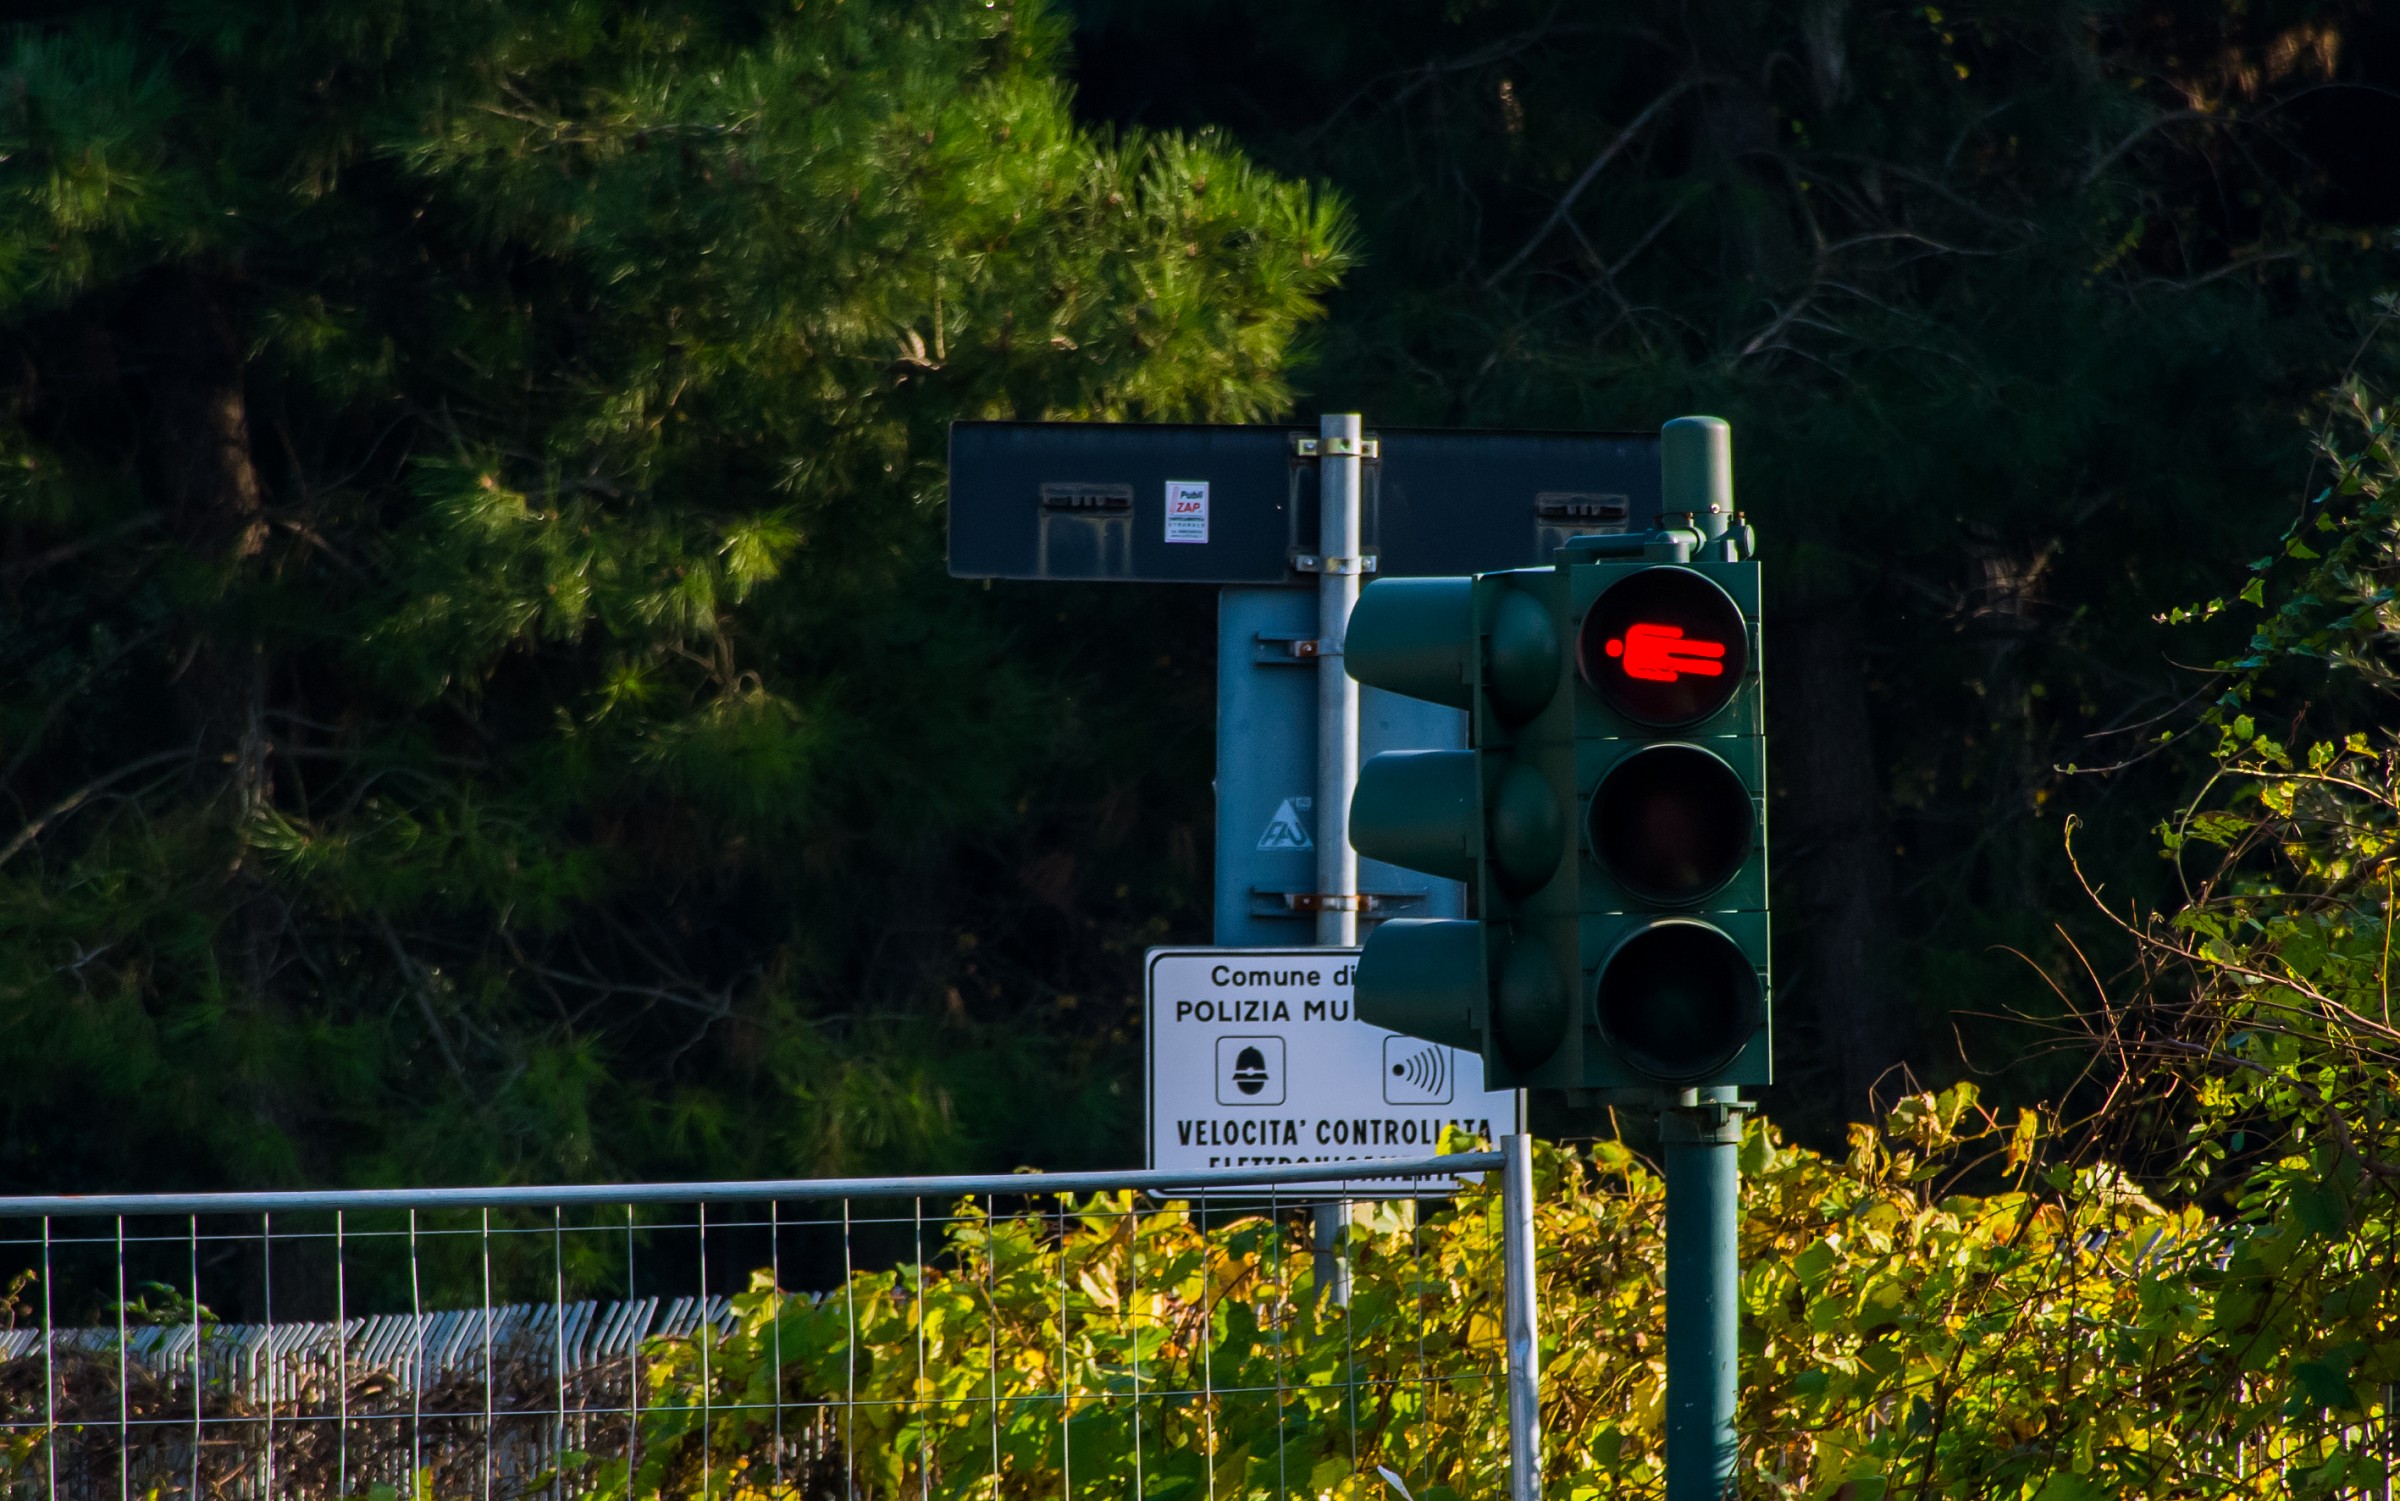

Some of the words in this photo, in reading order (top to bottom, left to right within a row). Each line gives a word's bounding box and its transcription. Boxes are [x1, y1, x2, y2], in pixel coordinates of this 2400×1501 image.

[1177, 502, 1200, 512] ZAP
[1211, 965, 1321, 987] Comune
[1333, 965, 1356, 987] di
[1176, 1001, 1290, 1022] POLIZIA
[1304, 1001, 1359, 1022] MU
[1177, 1120, 1306, 1146] VELOCITA'
[1316, 1119, 1491, 1145] CONTROLLTA
